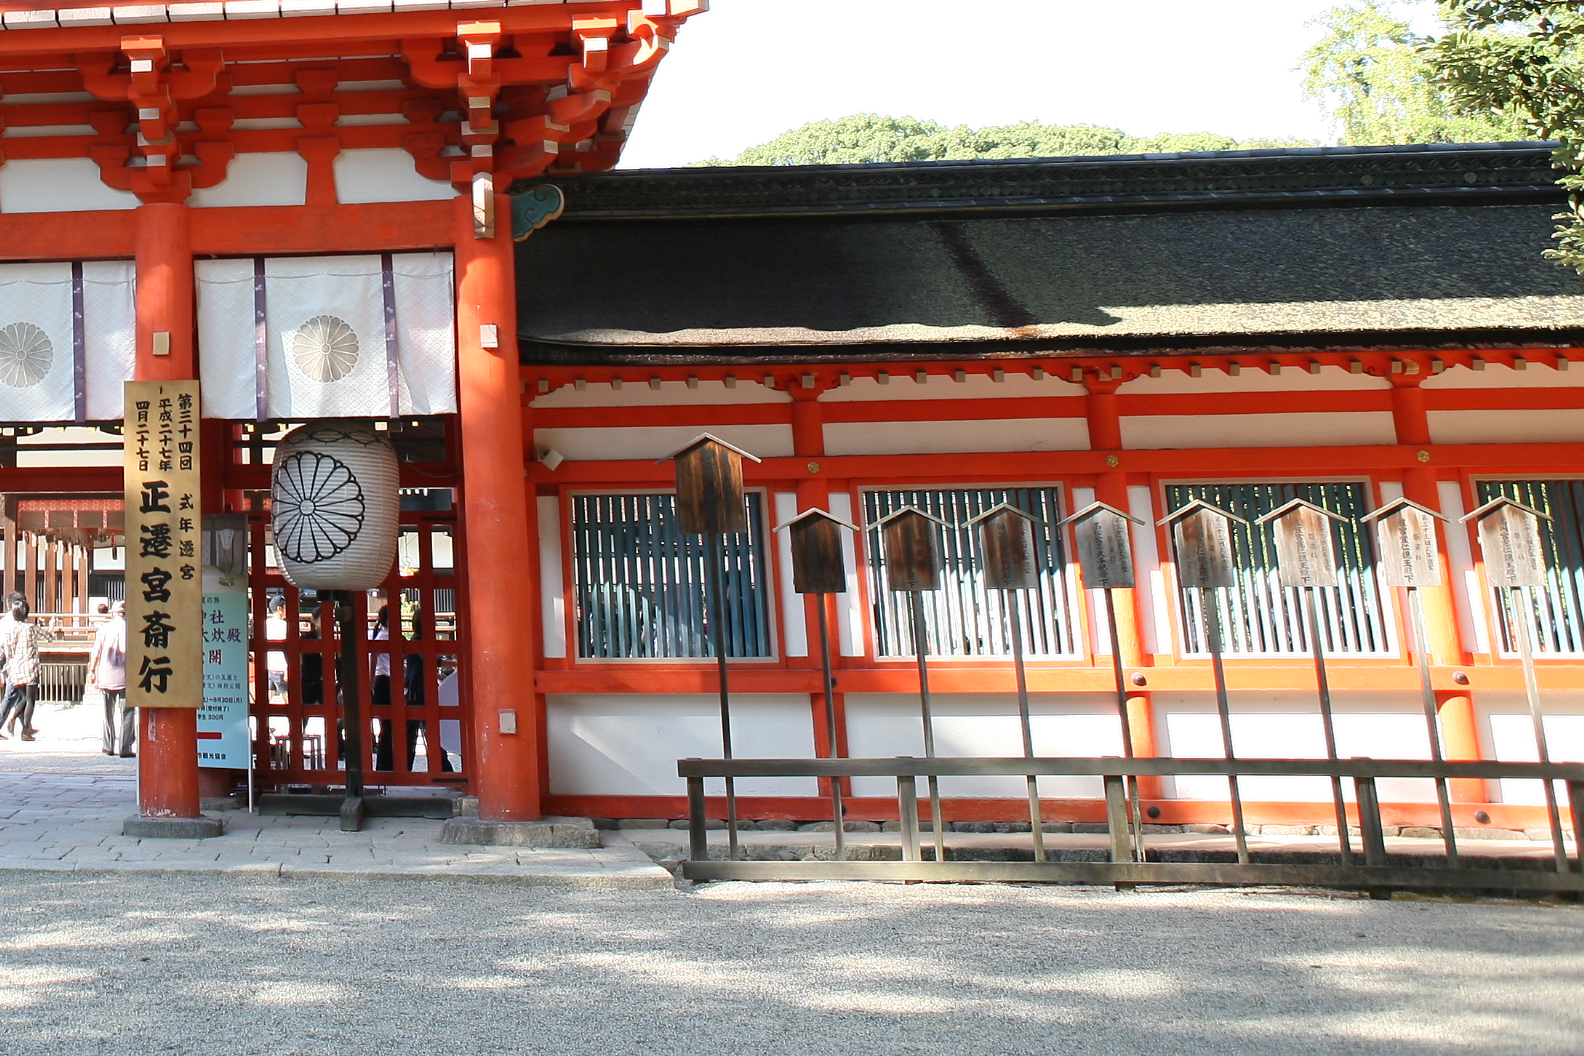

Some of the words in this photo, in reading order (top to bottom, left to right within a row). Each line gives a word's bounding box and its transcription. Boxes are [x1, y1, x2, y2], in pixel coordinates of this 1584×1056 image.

[136, 400, 151, 472] 四月二十七日
[158, 398, 173, 472] 平成二十七年
[177, 393, 193, 471] 第三十四回
[179, 493, 194, 580] 式年遷宮
[203, 649, 222, 665] 開
